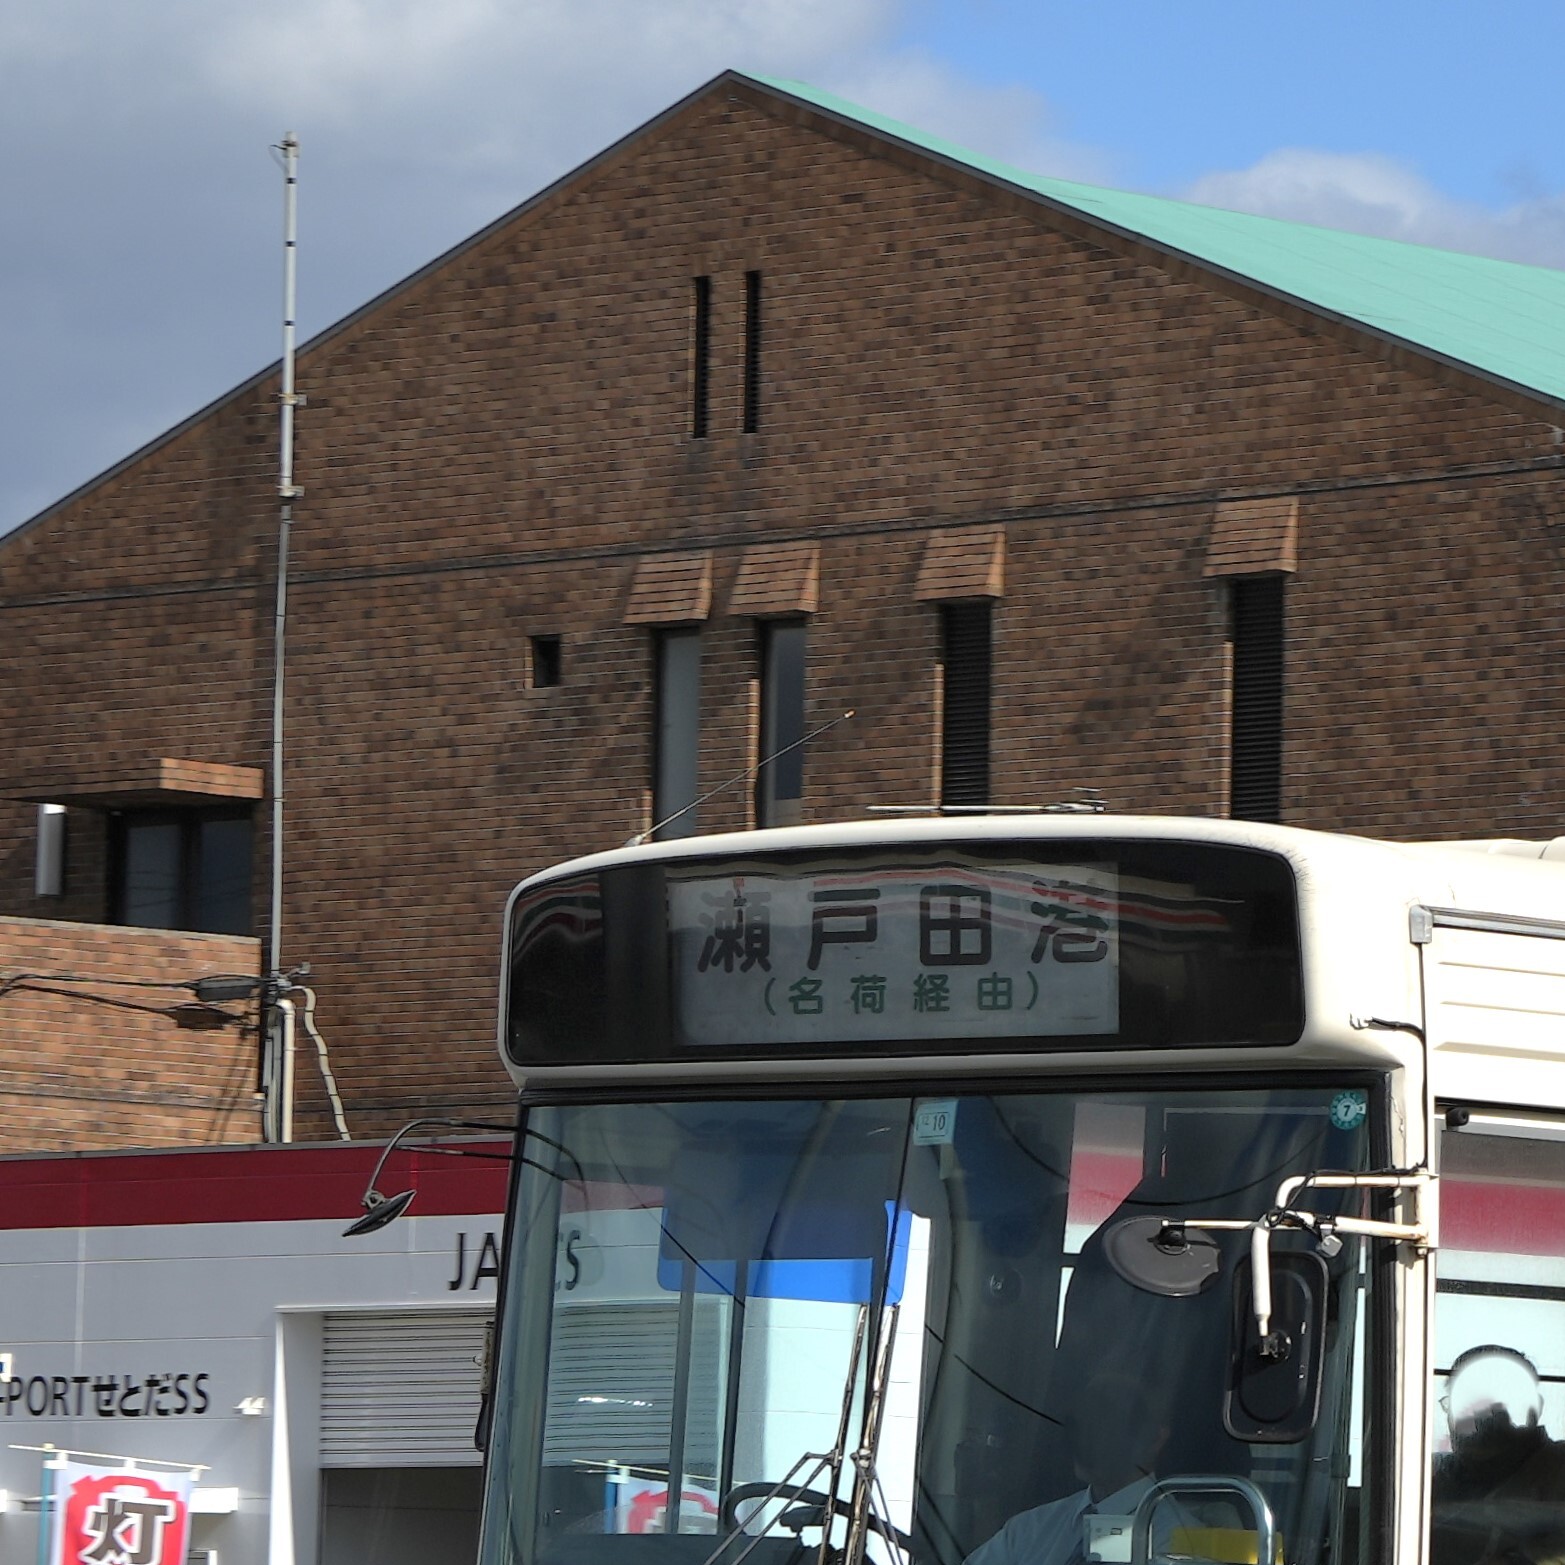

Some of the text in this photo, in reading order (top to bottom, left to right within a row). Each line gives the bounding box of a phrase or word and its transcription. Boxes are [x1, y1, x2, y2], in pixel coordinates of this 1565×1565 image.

[698, 879, 1110, 973] 瀬戸田港
[764, 970, 1040, 1016] (名荷経由)
[0, 1373, 209, 1417] PORTせとだSS
